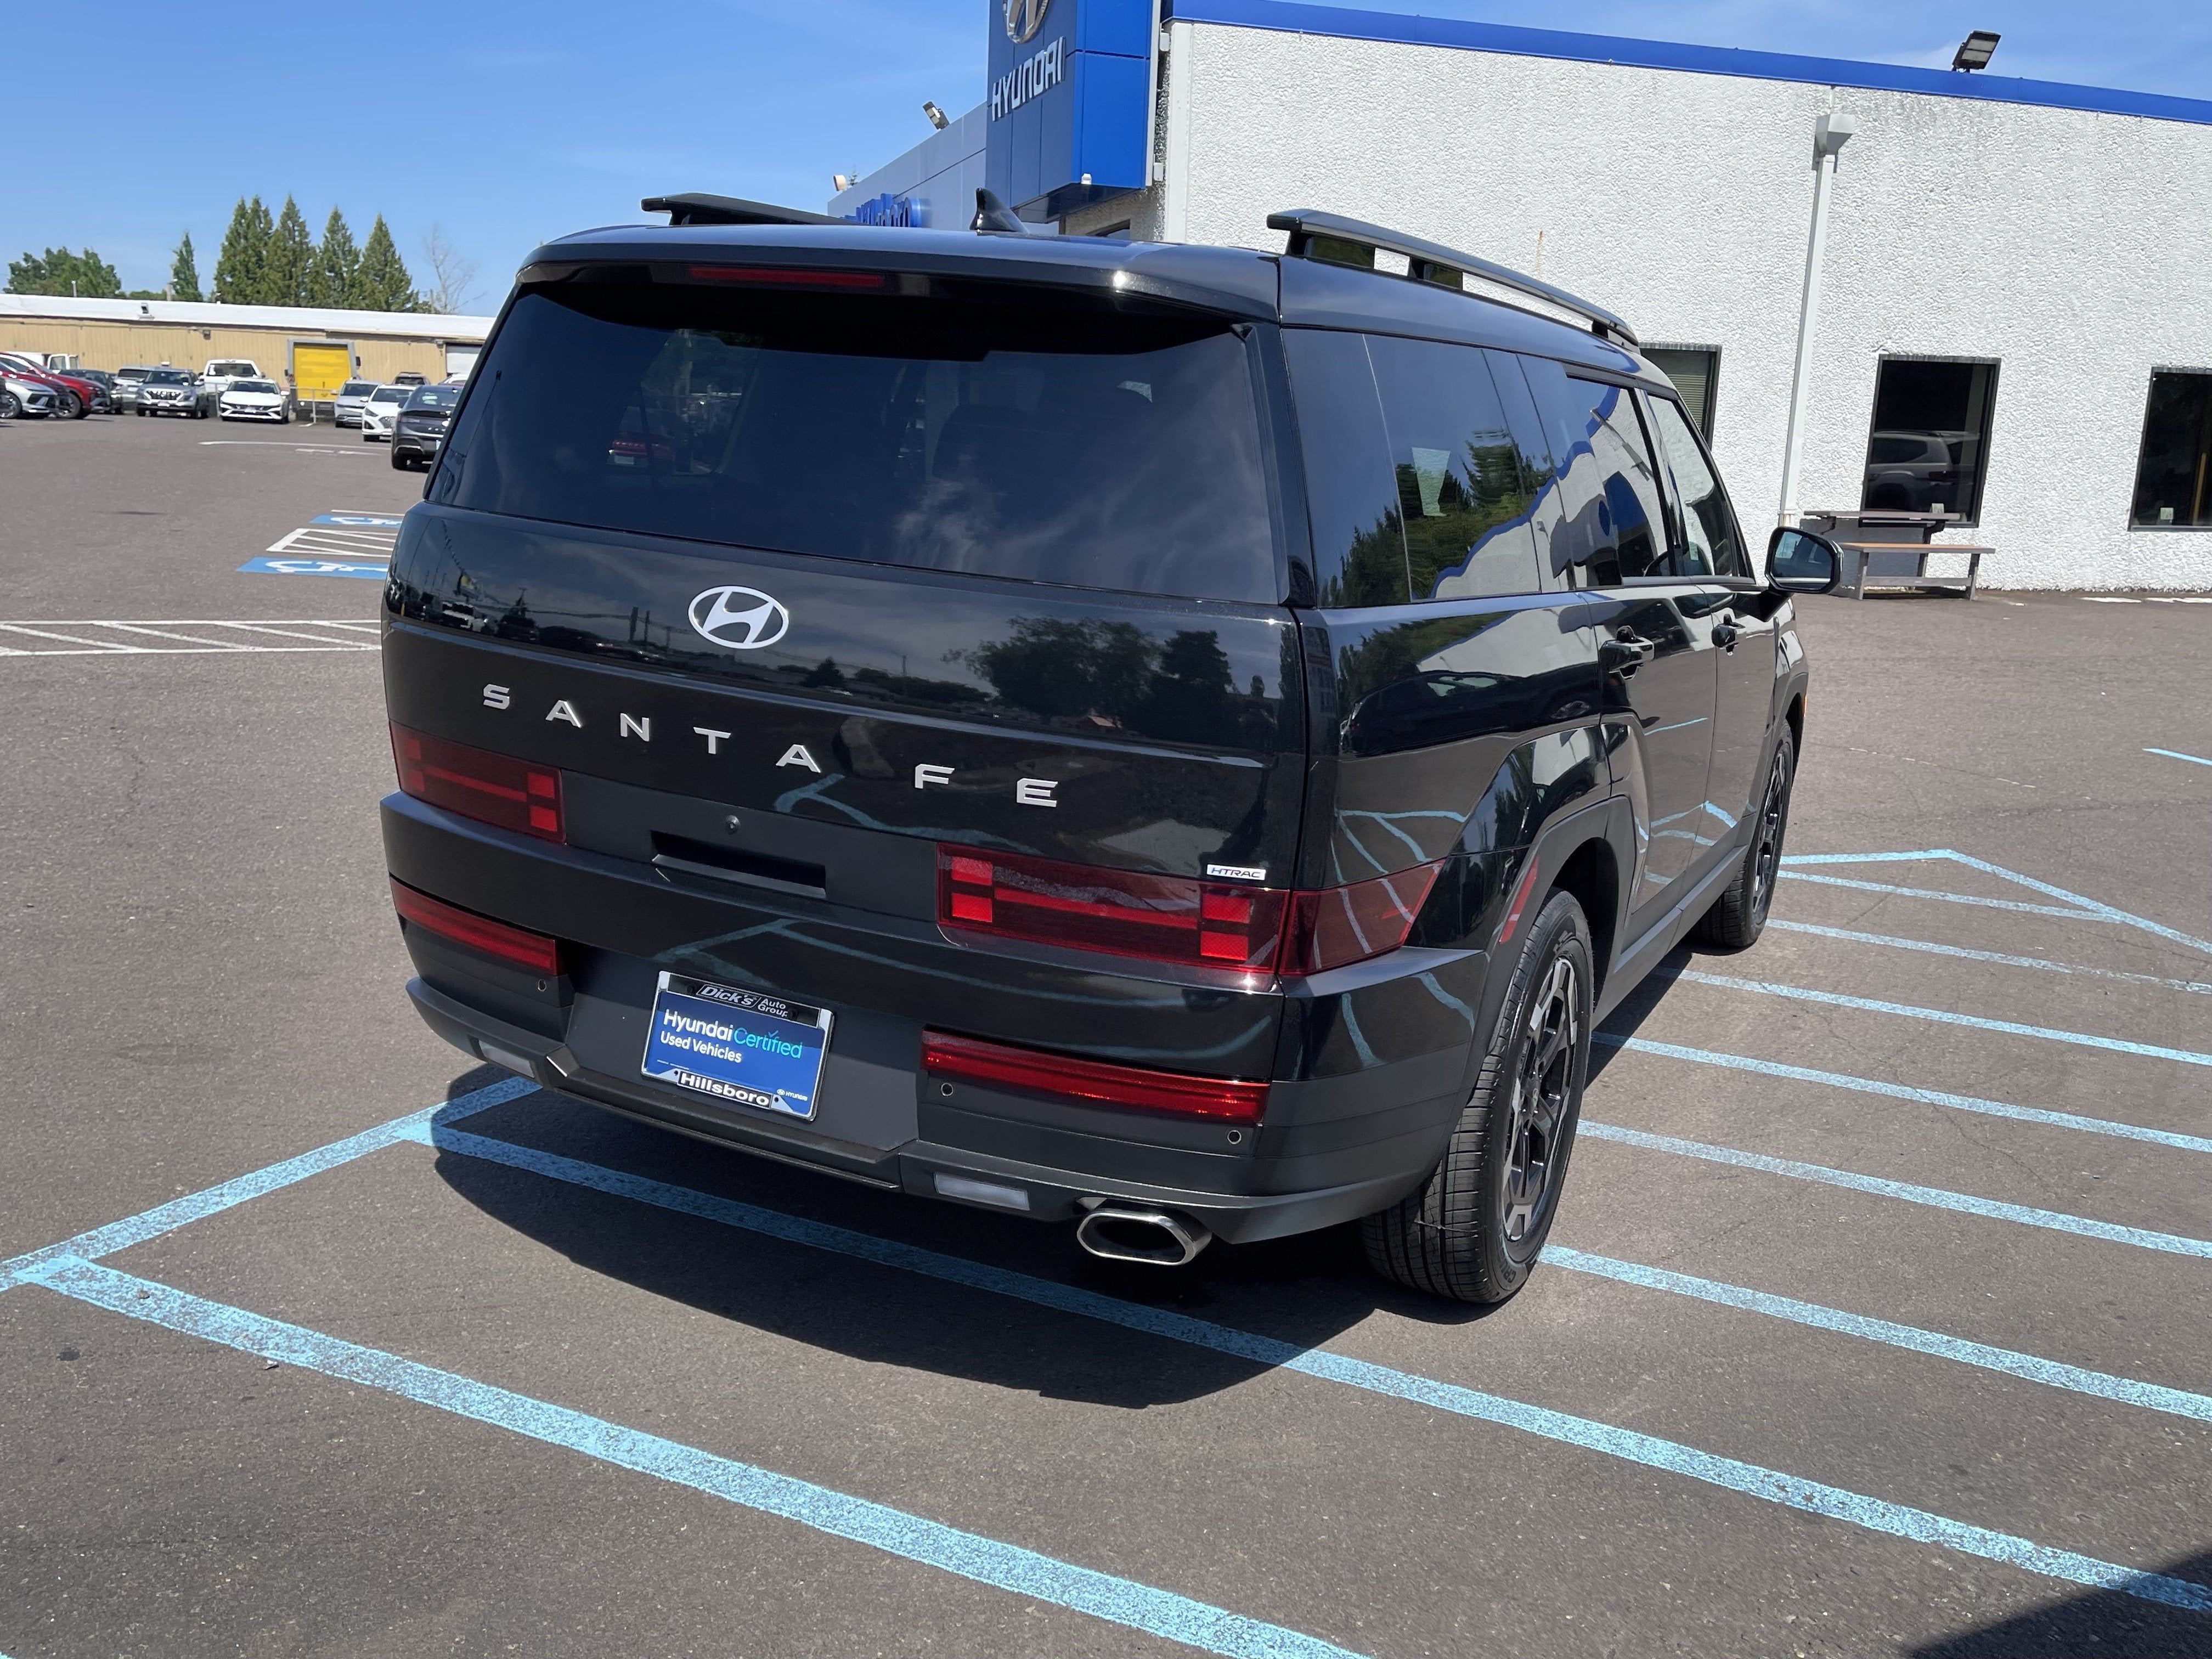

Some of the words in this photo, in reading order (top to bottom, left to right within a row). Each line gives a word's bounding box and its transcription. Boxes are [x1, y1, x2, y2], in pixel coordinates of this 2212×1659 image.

[991, 36, 1065, 122] HYUNDAI
[483, 684, 821, 773] SANTA
[915, 763, 1058, 808] FE
[1211, 867, 1261, 878] HTRAC
[701, 986, 754, 1006] Dick's
[760, 998, 786, 1009] Auto
[660, 1030, 691, 1050] Used
[692, 1038, 742, 1063] Vehicles
[663, 1009, 735, 1042] Hyundai
[733, 1027, 803, 1059] Certified
[680, 1072, 769, 1105] Hillsboro
